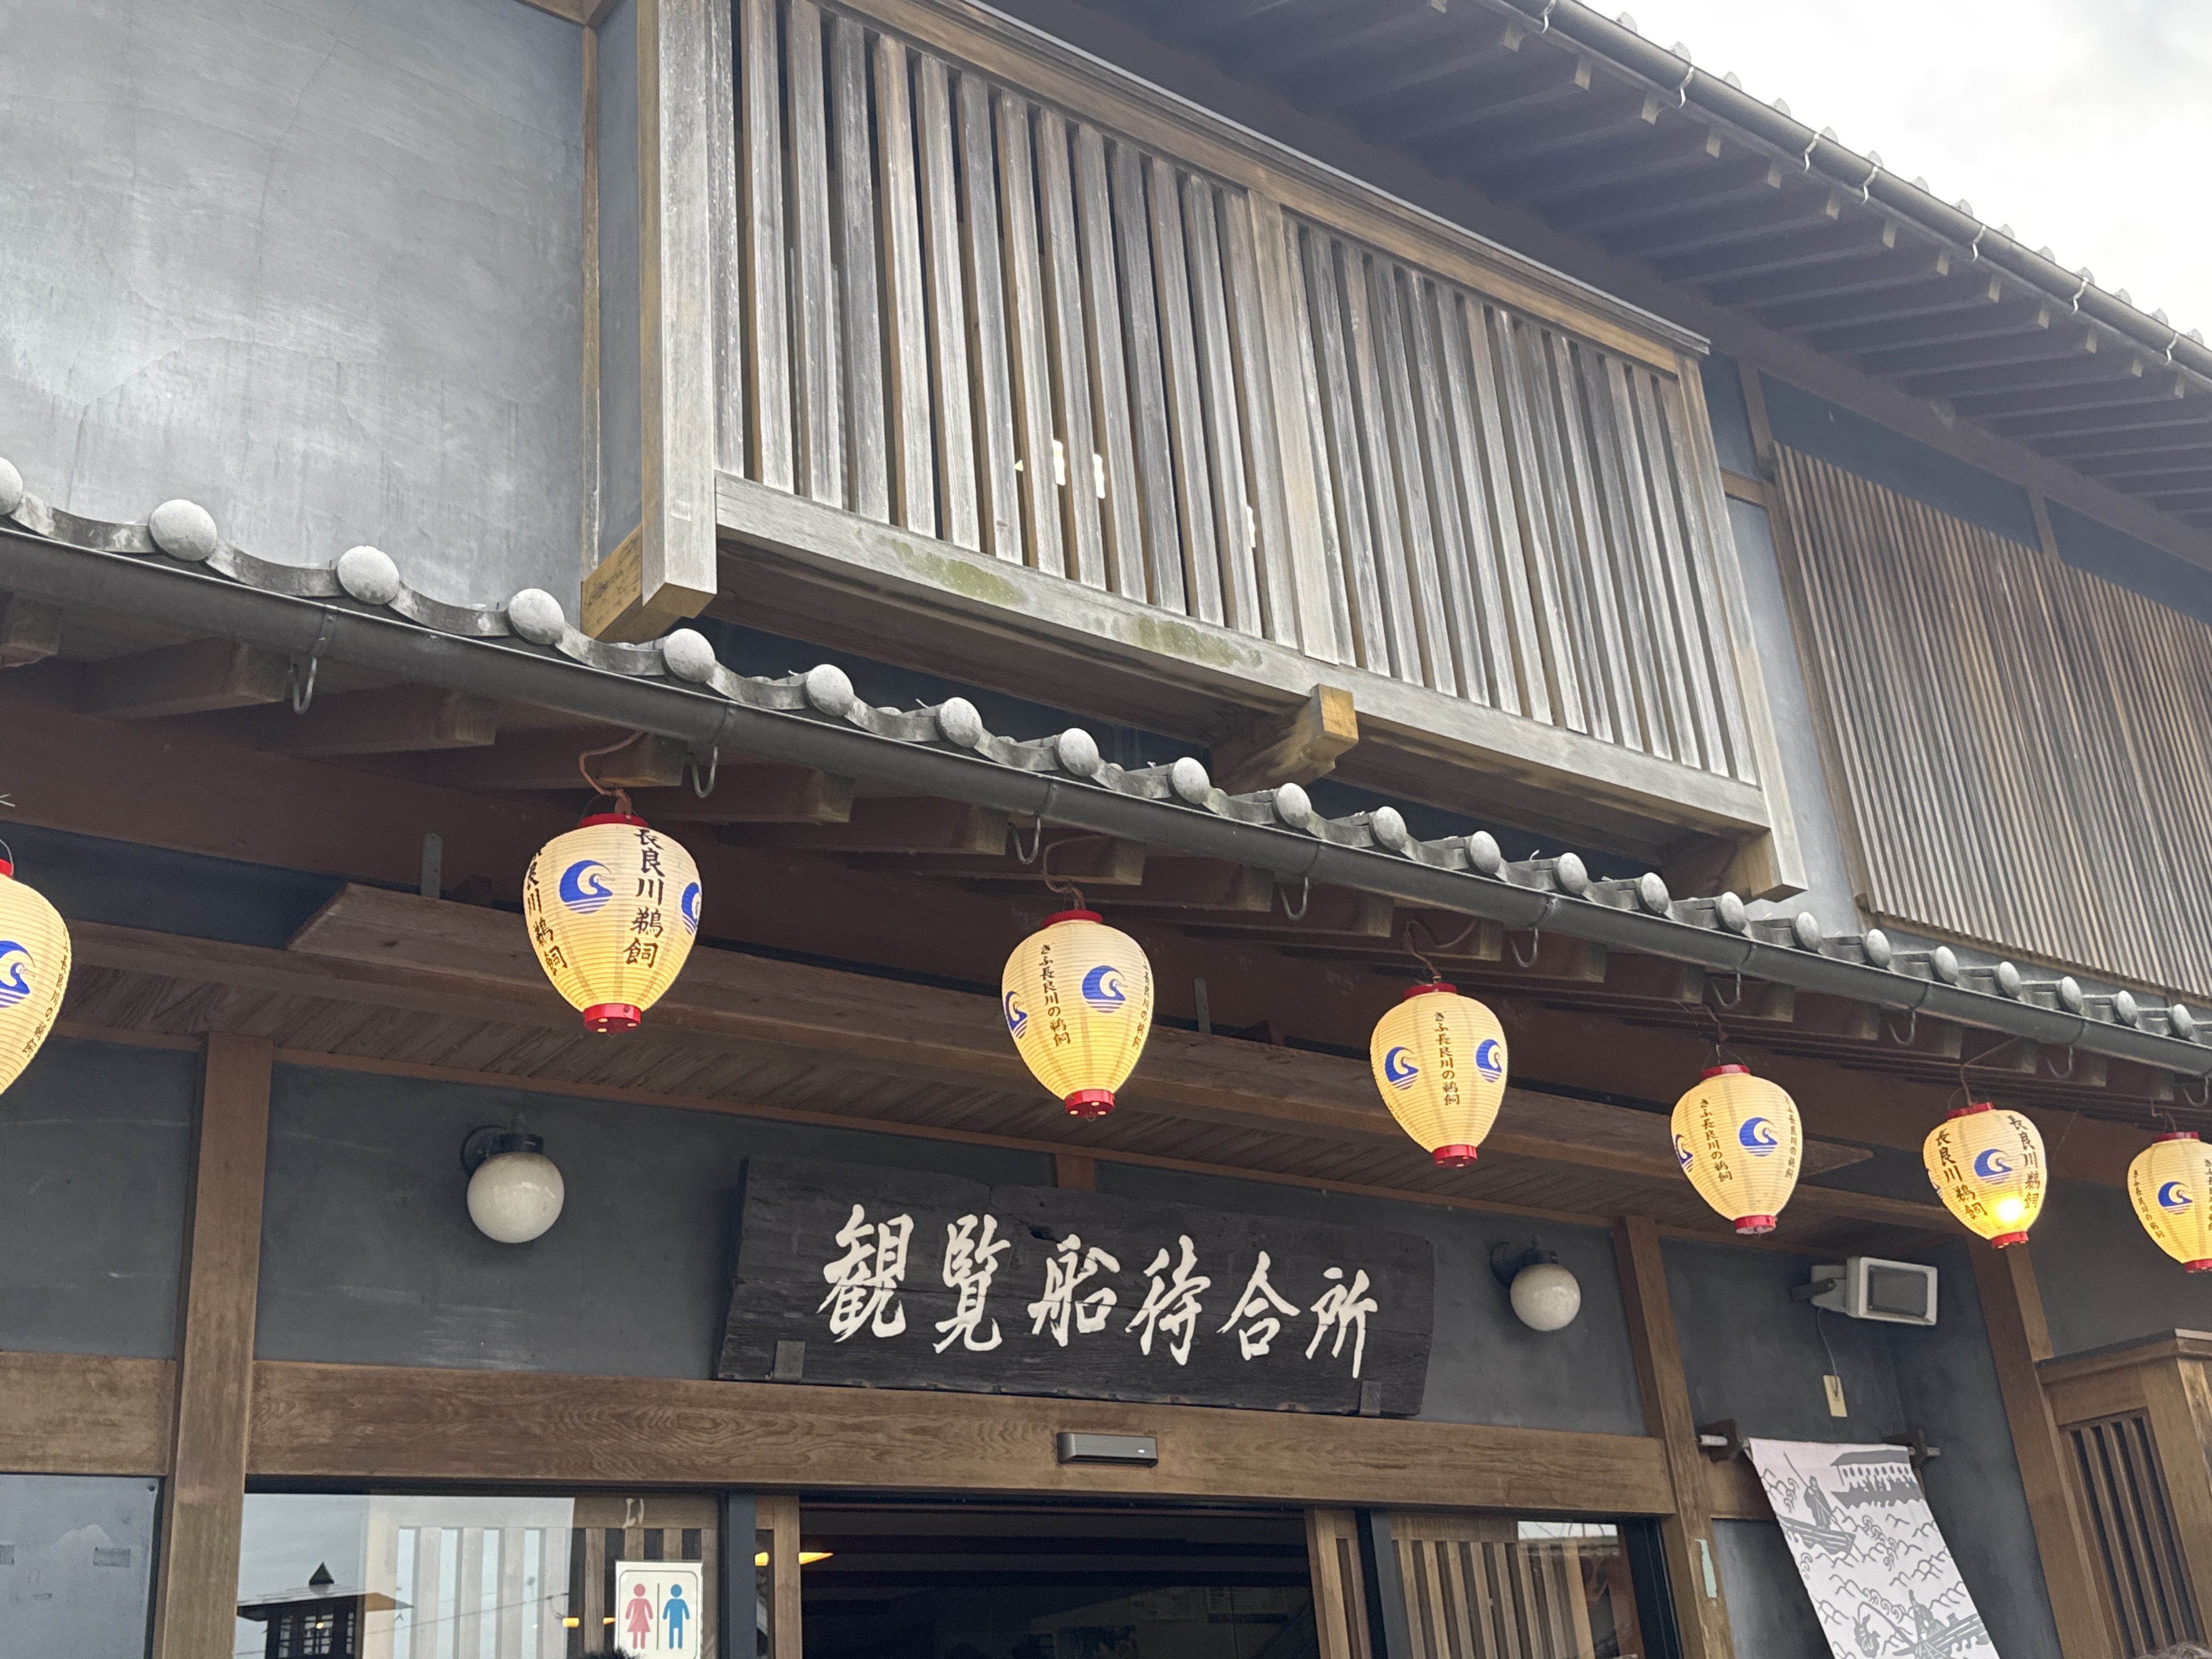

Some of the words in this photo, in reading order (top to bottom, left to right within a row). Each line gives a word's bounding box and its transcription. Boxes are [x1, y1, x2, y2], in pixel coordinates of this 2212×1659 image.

[526, 845, 568, 977] 良川鵜飼
[623, 828, 665, 969] 長良川鵜飼
[1935, 1128, 1988, 1220] 長良川鵜飼
[2007, 1115, 2041, 1210] 長良川鵜飼
[816, 1203, 1379, 1380] 観覧船待合所
